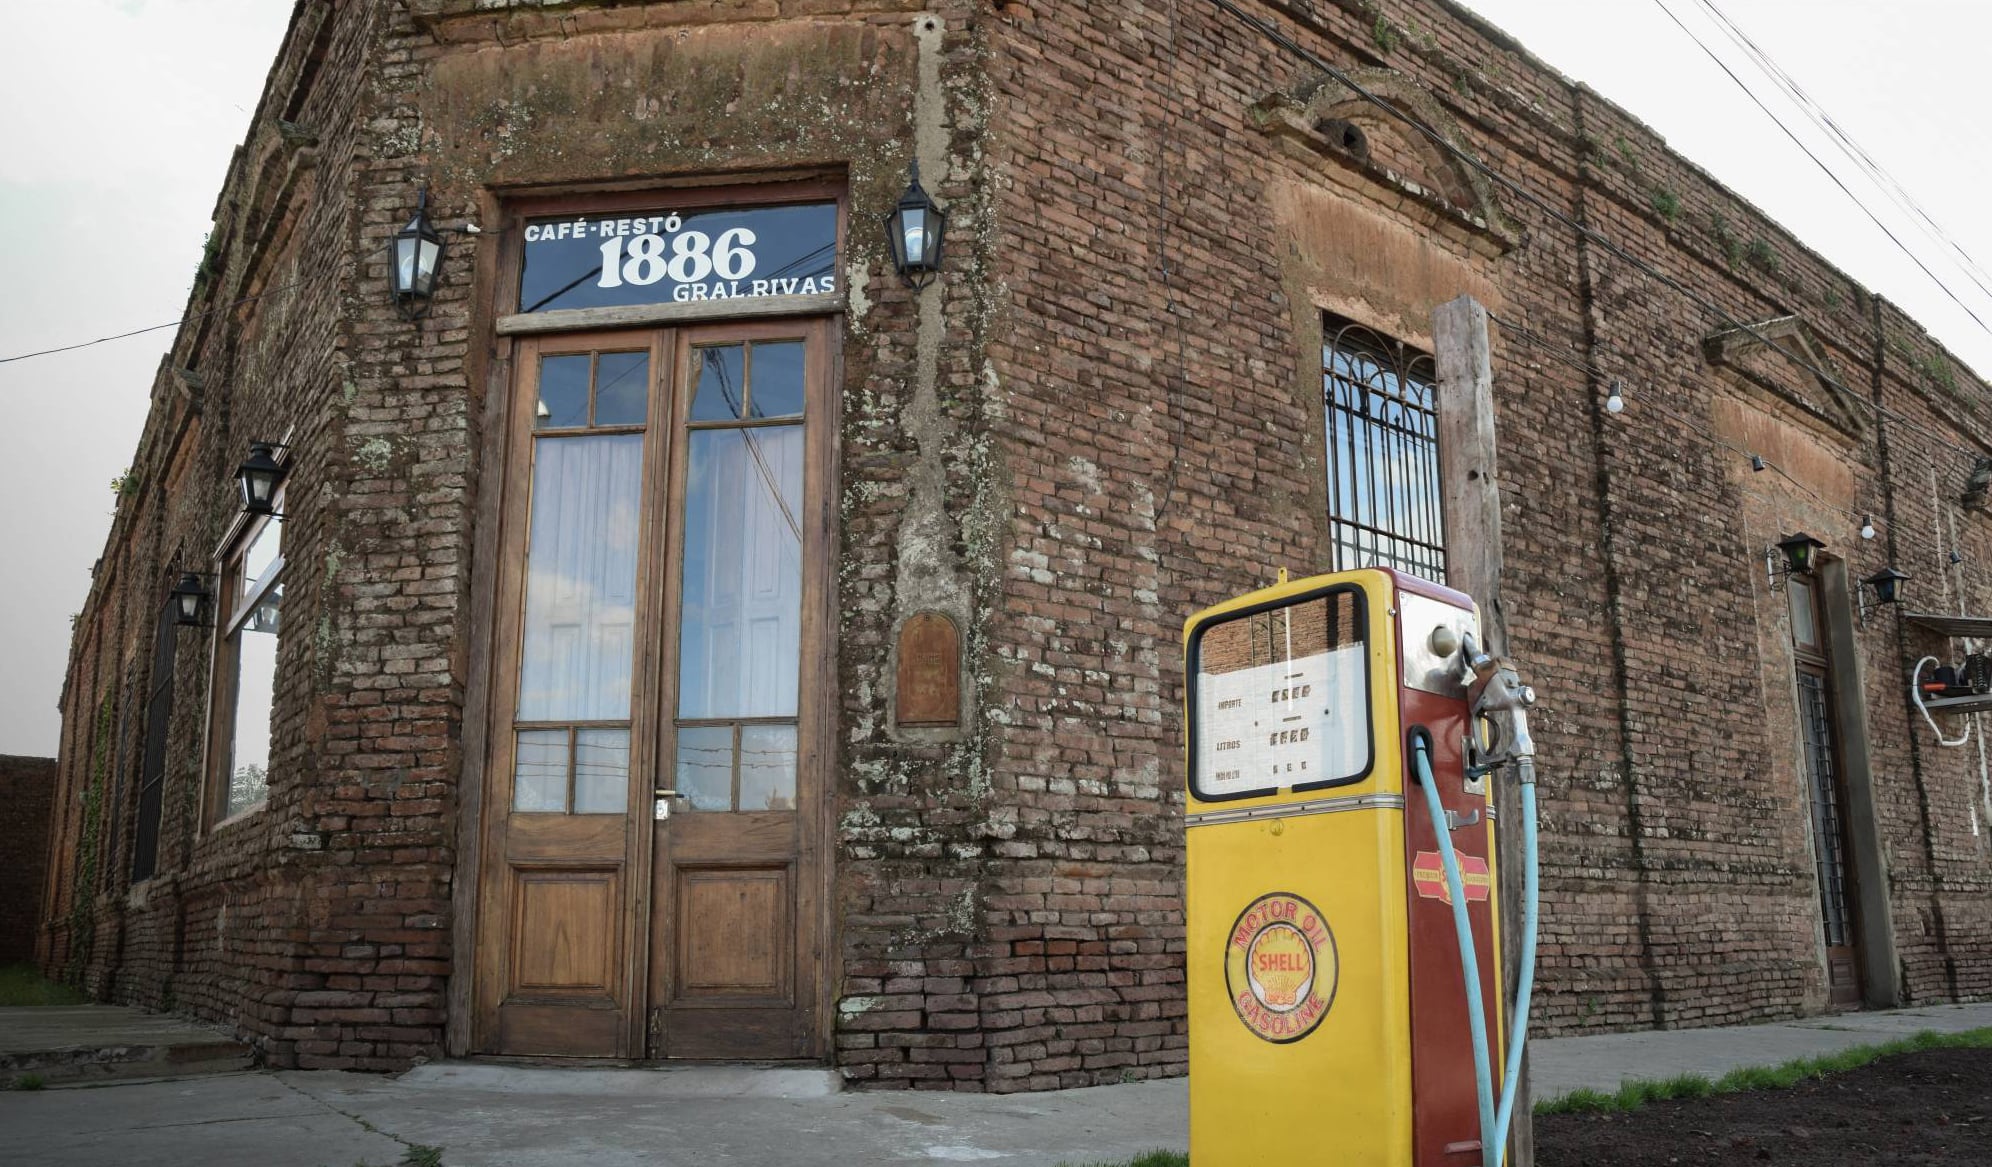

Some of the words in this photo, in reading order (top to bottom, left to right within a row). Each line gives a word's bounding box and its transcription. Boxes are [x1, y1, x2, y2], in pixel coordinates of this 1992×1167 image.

[597, 227, 757, 288] 1886
[1216, 740, 1240, 751] LITROS
[1232, 900, 1298, 950] MOTOR
[1302, 913, 1328, 952] OIL
[1259, 953, 1304, 971] SHELL
[1238, 990, 1325, 1034] GASOLINE
